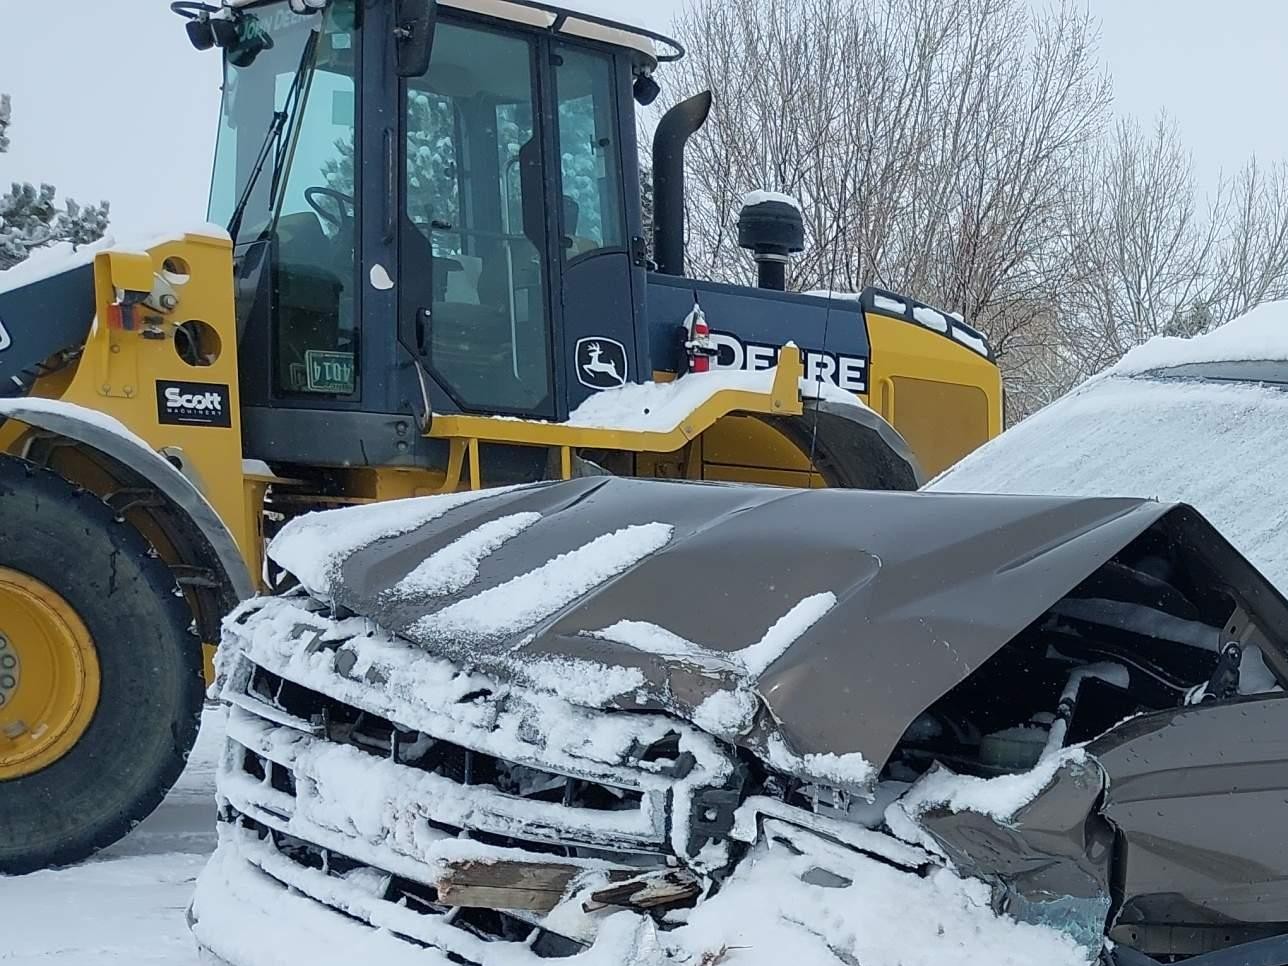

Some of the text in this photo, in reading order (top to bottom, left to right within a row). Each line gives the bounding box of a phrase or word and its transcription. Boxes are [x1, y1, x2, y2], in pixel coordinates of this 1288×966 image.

[708, 332, 866, 391] DERE
[165, 387, 222, 410] Scott
[166, 407, 222, 415] MACHINERY
